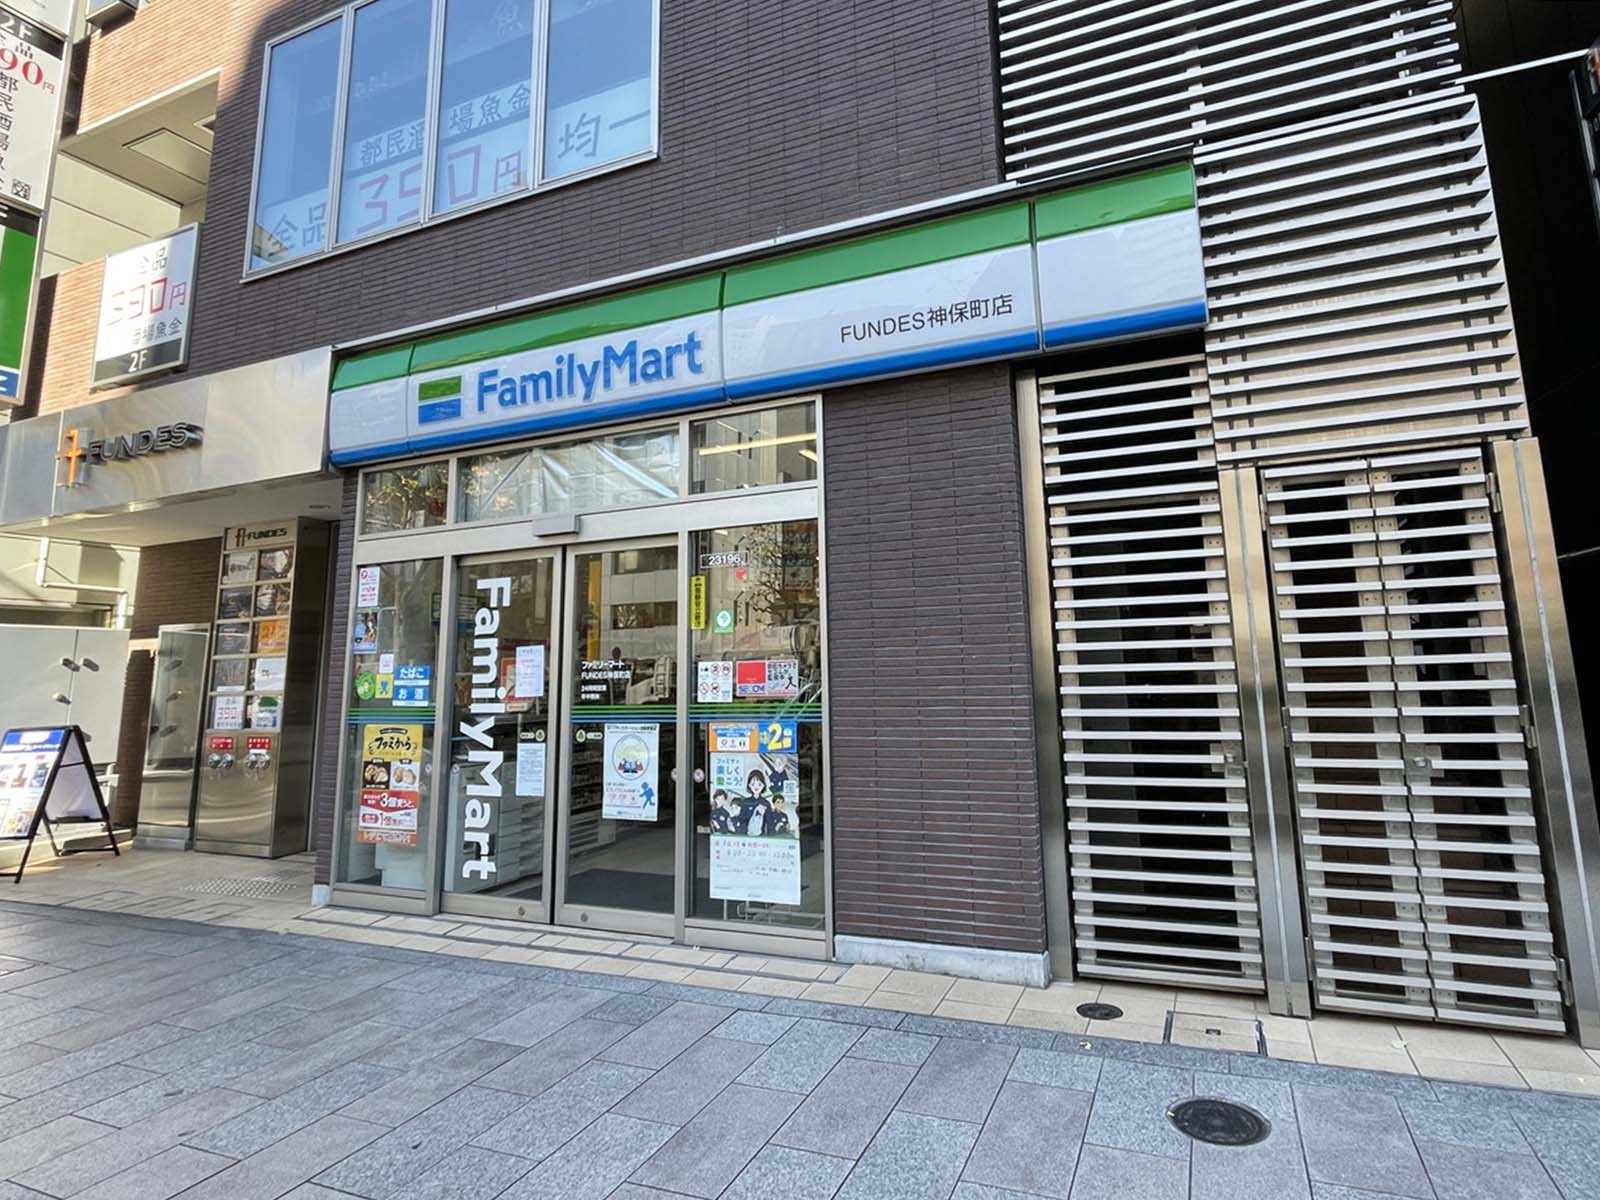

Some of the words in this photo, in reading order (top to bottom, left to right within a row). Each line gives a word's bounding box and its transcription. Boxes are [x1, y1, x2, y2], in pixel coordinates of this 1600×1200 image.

[840, 294, 1013, 343] FUNDES神保町店
[127, 350, 148, 373] 2F
[477, 330, 703, 412] FamilyMart
[86, 422, 190, 465] FUNDES
[247, 527, 287, 540] FUNDES
[708, 553, 741, 566] 23196
[399, 667, 425, 679] たばこ
[738, 684, 766, 693] SEOM
[459, 577, 512, 880] FamilyMart
